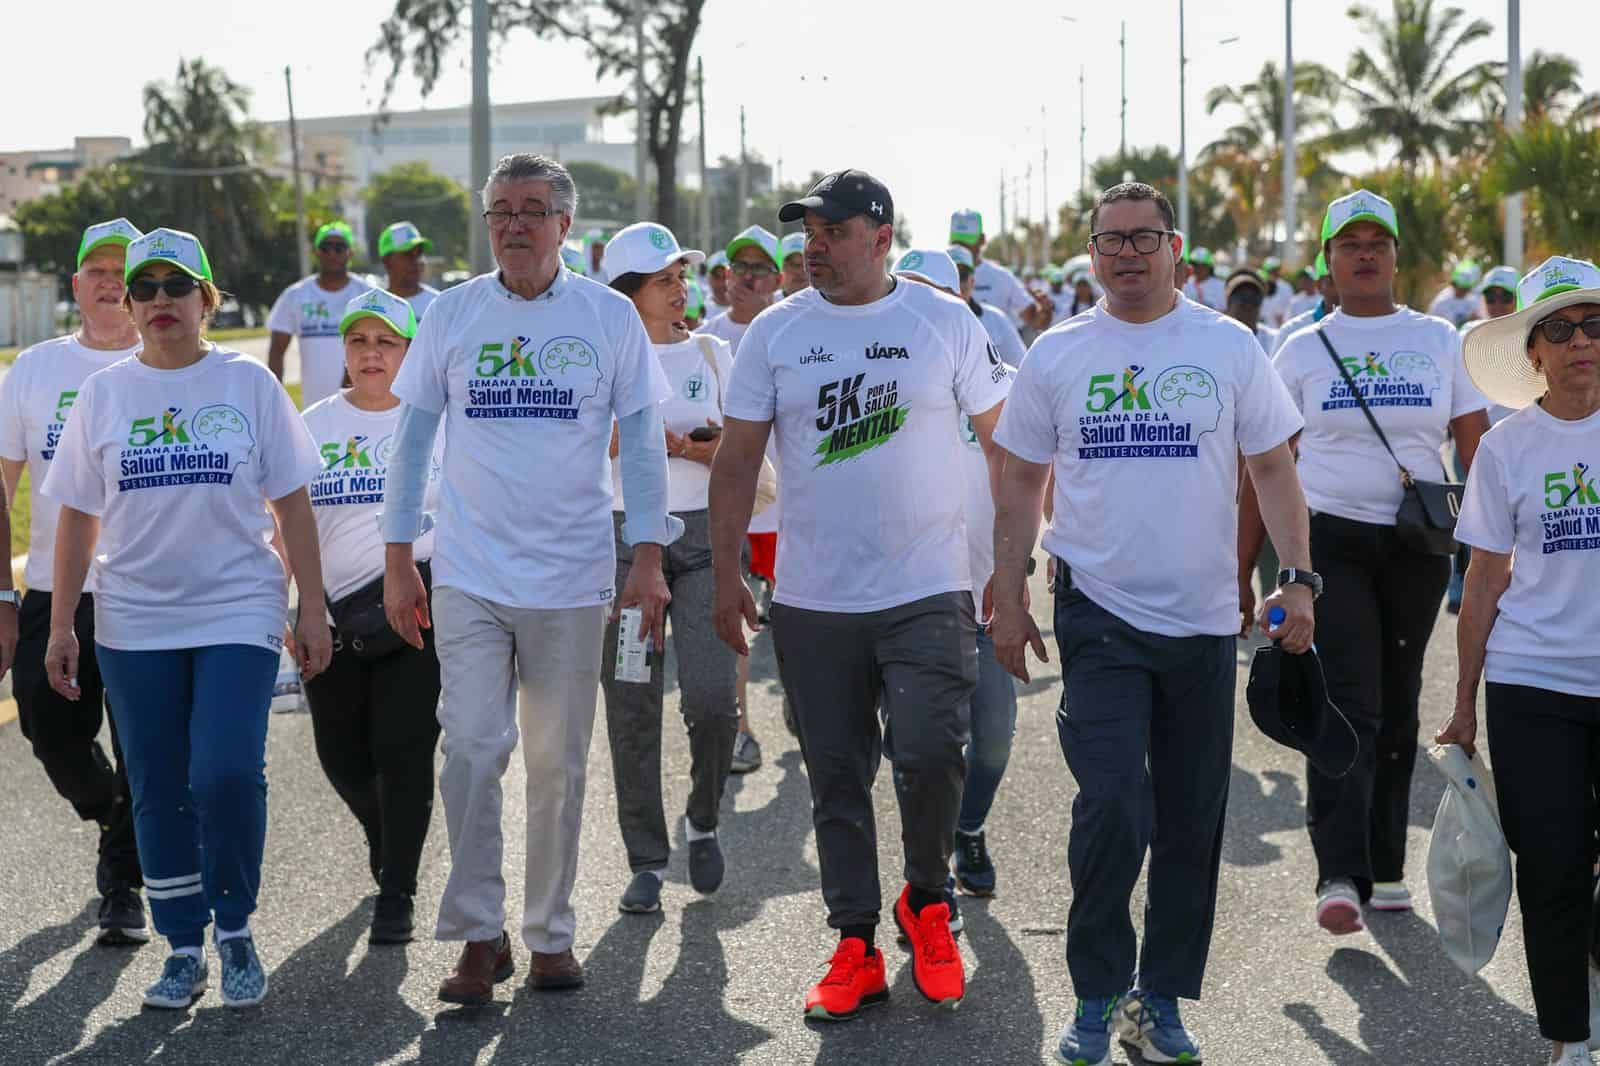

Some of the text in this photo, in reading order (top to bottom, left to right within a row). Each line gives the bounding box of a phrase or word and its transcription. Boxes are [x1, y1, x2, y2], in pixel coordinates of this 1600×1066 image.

[800, 353, 834, 364] UFHEC
[865, 343, 910, 360] UAPA
[468, 378, 554, 388] SEMANA DE LA
[1329, 381, 1425, 399] Sald Mental
[469, 387, 573, 406] Salud Mental
[816, 372, 866, 431] 5K
[887, 380, 898, 394] LA
[864, 392, 898, 415] SALUD
[471, 408, 575, 419] PENITENCIARIA
[1080, 412, 1170, 425] SEMANA DE LA
[828, 407, 900, 454] MENTAL
[1080, 423, 1191, 445] Salud Mental
[121, 443, 208, 458] SEMANA DE LA
[1083, 446, 1193, 458] PENITENCIARIA
[121, 451, 229, 476] Salud Mental
[123, 473, 230, 489] PENITENCIARIA
[1540, 507, 1585, 522] SEMANA
[1543, 516, 1583, 540] Salud
